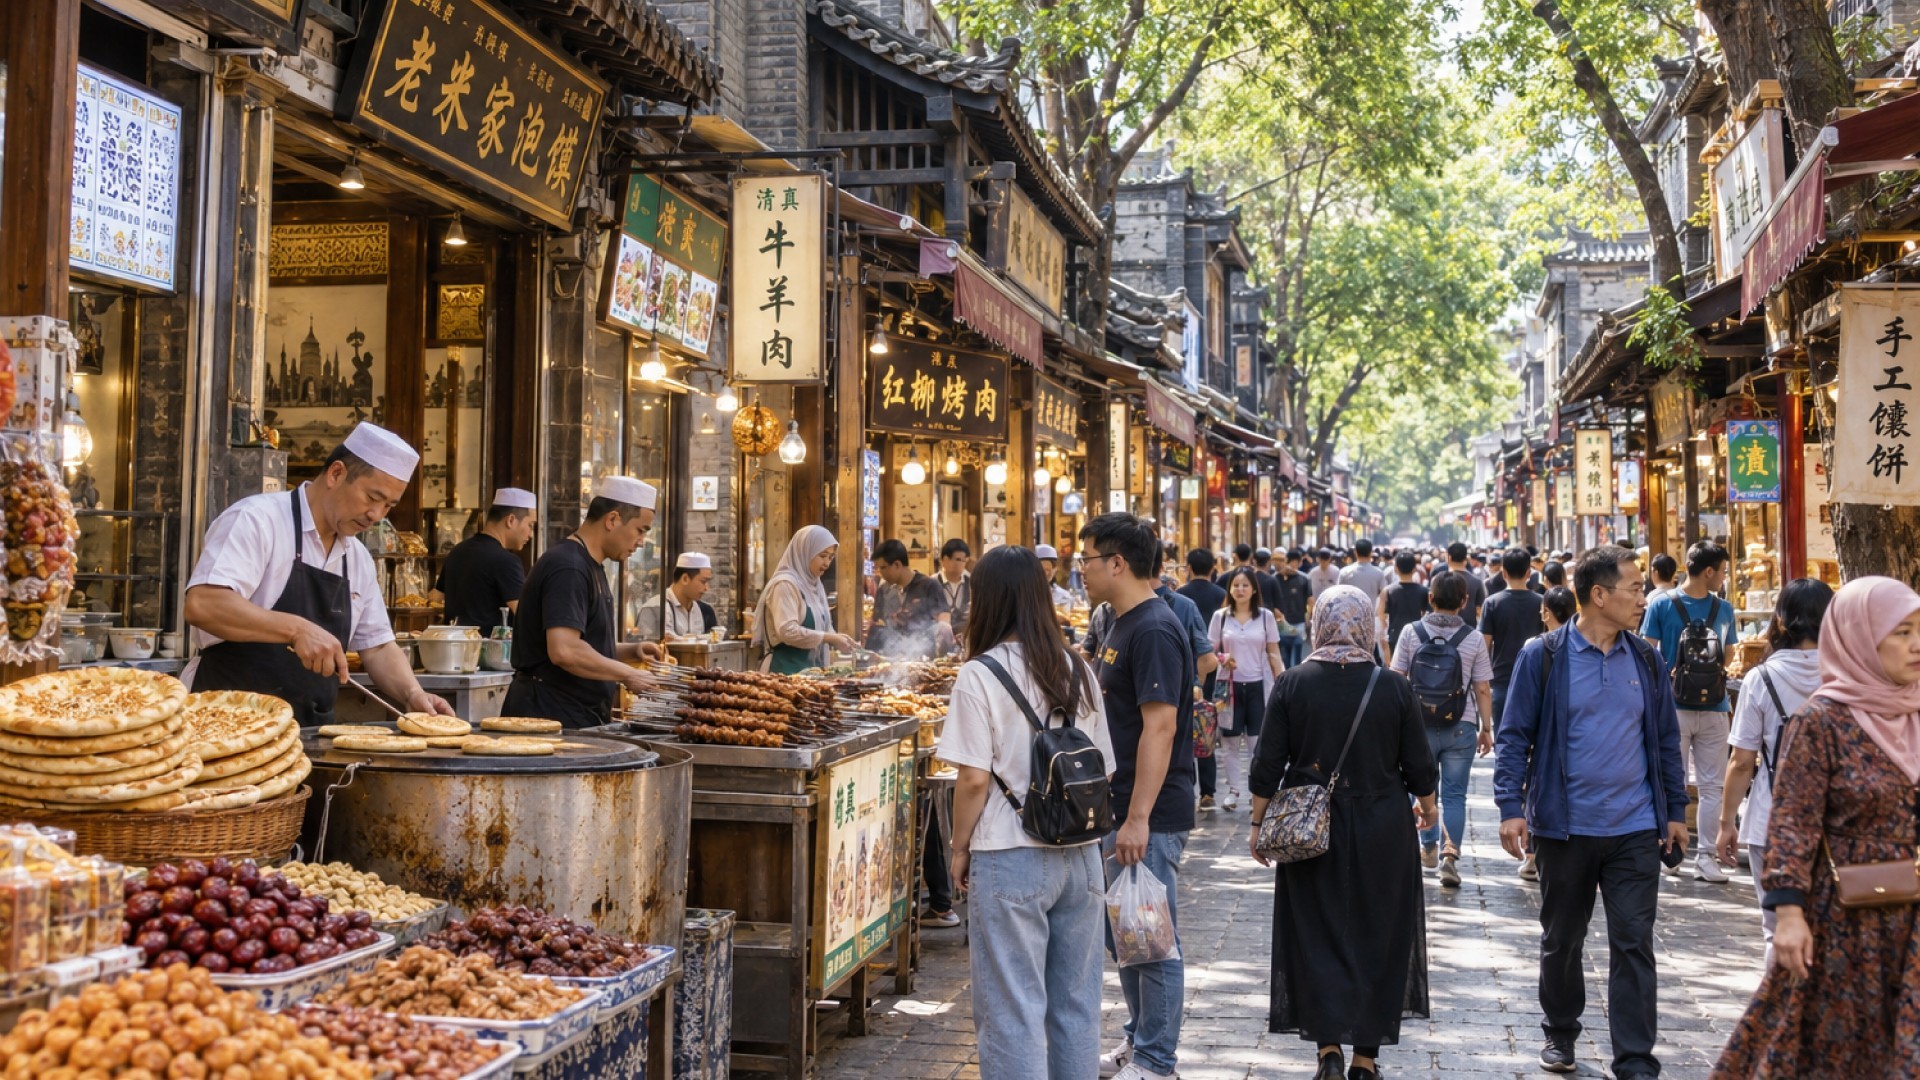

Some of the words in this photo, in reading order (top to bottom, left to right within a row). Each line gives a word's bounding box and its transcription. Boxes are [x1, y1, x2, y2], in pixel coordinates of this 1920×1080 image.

[757, 186, 799, 211] 清真
[758, 220, 795, 369] 牛羊肉
[882, 364, 997, 422] 红柳烤肉
